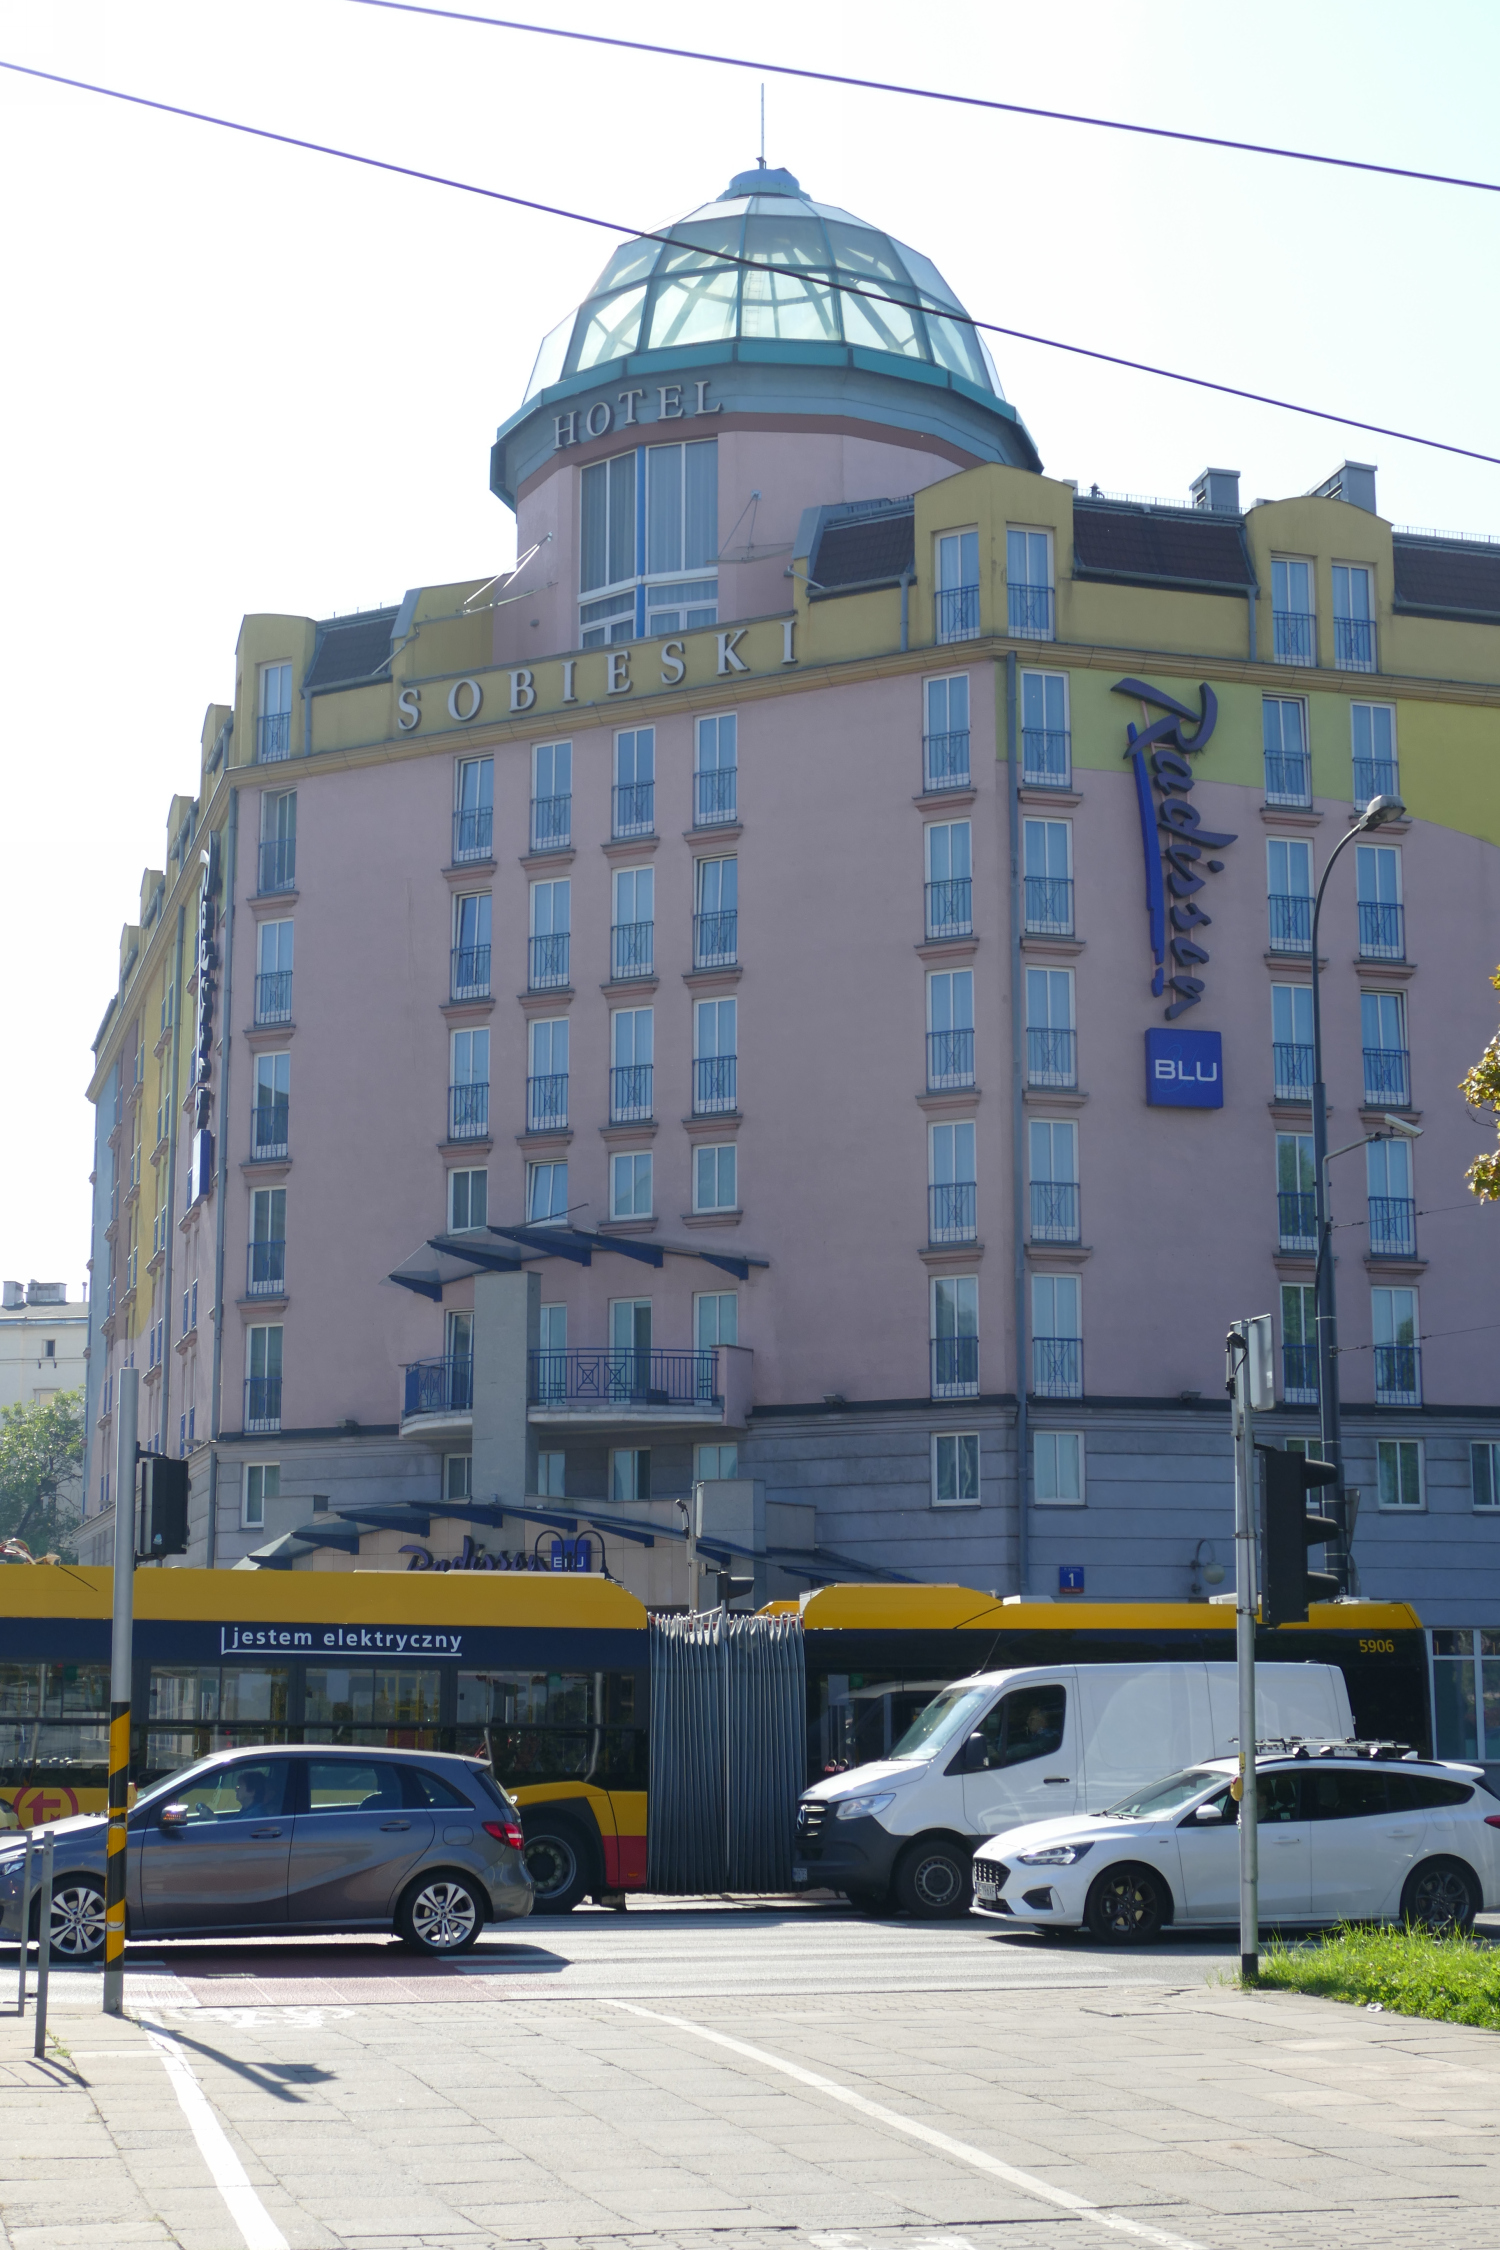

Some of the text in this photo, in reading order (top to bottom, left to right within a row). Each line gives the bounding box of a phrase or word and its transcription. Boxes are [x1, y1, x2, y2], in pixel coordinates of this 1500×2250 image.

[552, 380, 722, 450] HOTEL
[397, 621, 797, 732] SOBIESKI
[1110, 677, 1238, 1021] Radisson
[1154, 1059, 1218, 1082] BLU
[1068, 1572, 1075, 1587] 1
[232, 1627, 462, 1652] jestem elektryczny
[1359, 1639, 1395, 1653] 5906
